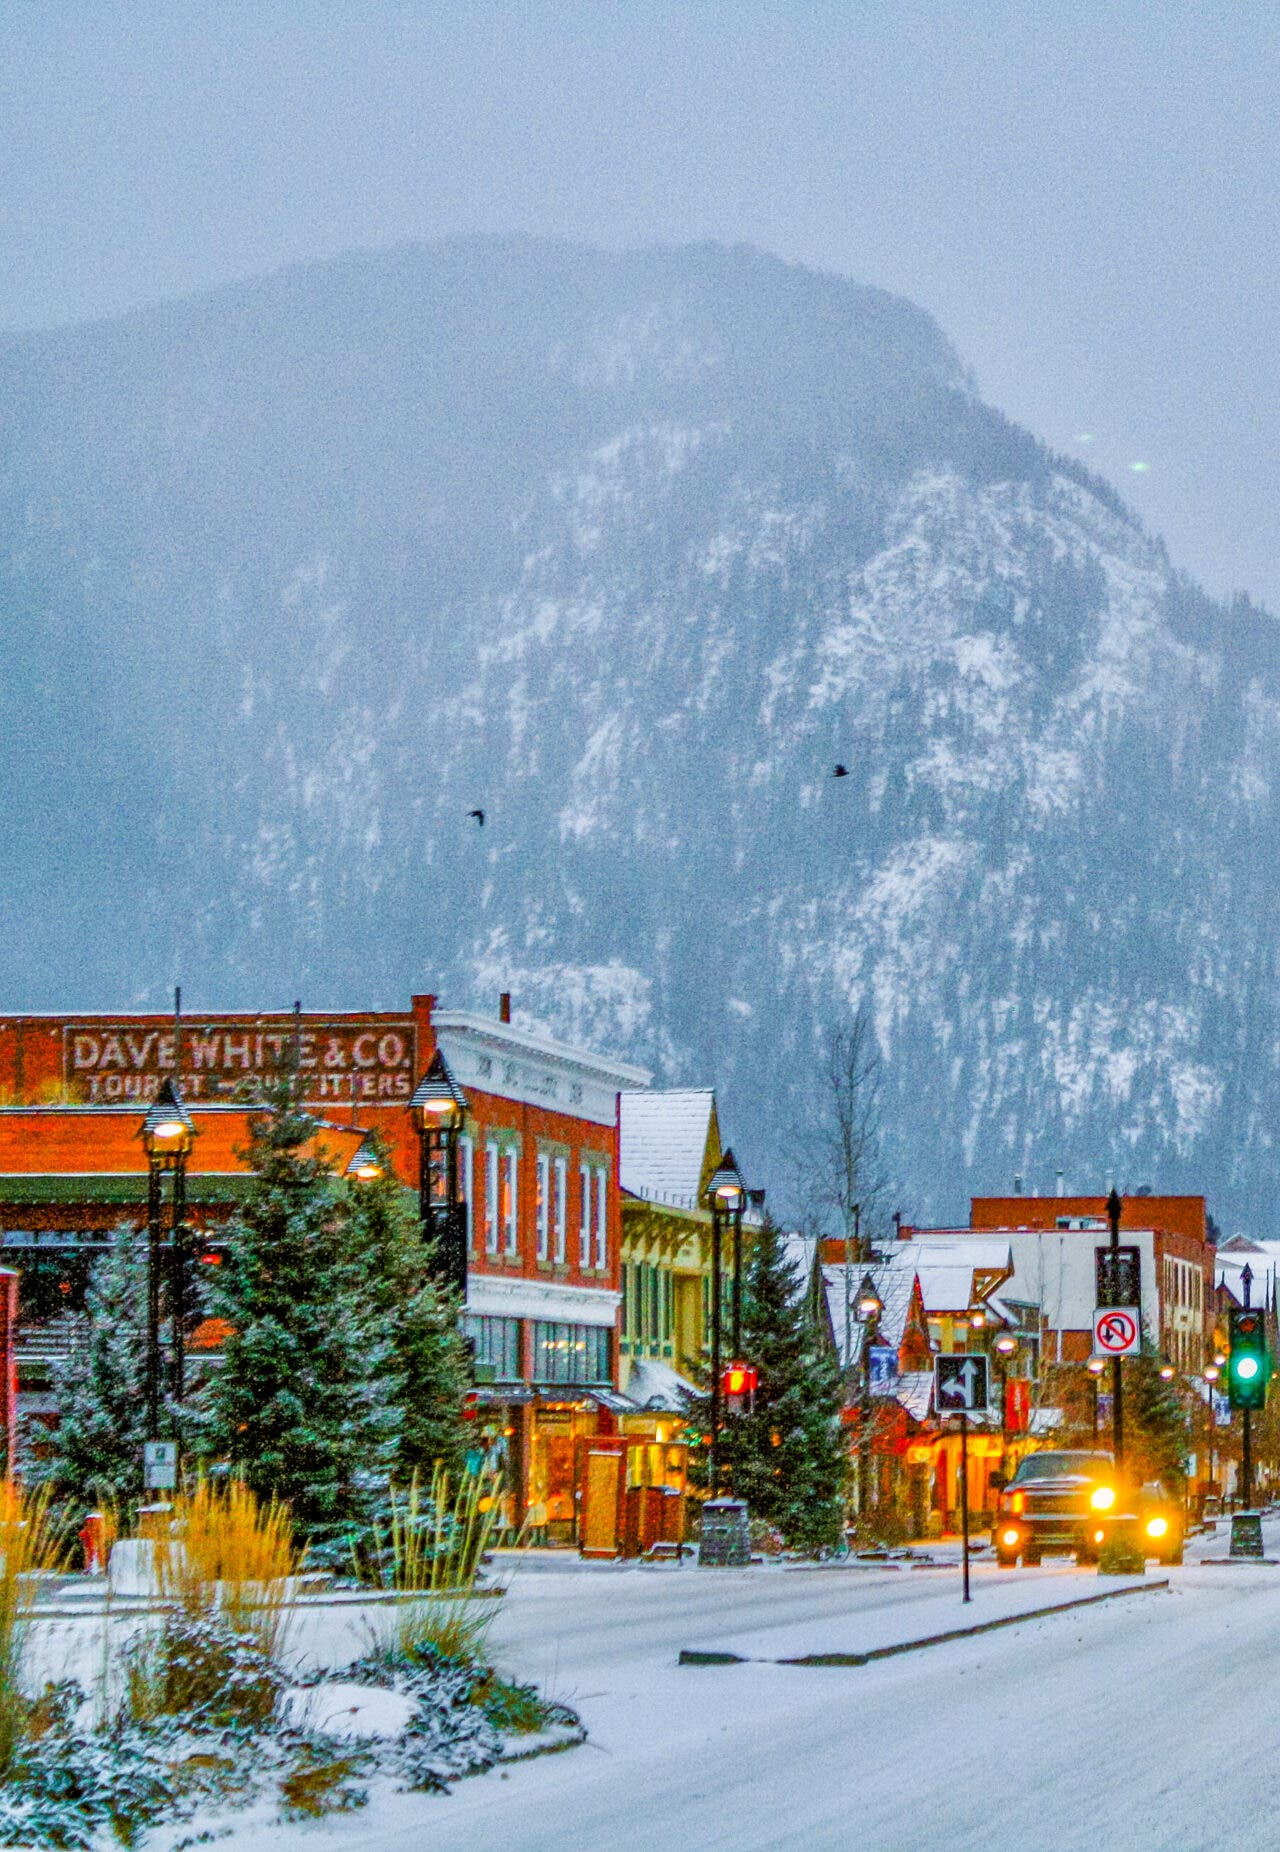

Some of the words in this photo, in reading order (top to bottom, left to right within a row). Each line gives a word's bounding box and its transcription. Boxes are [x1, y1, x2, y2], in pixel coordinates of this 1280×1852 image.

[74, 1033, 176, 1069] DAVE
[192, 1033, 317, 1069] WHITE
[324, 1038, 346, 1068] &
[87, 1075, 203, 1097] TOURST
